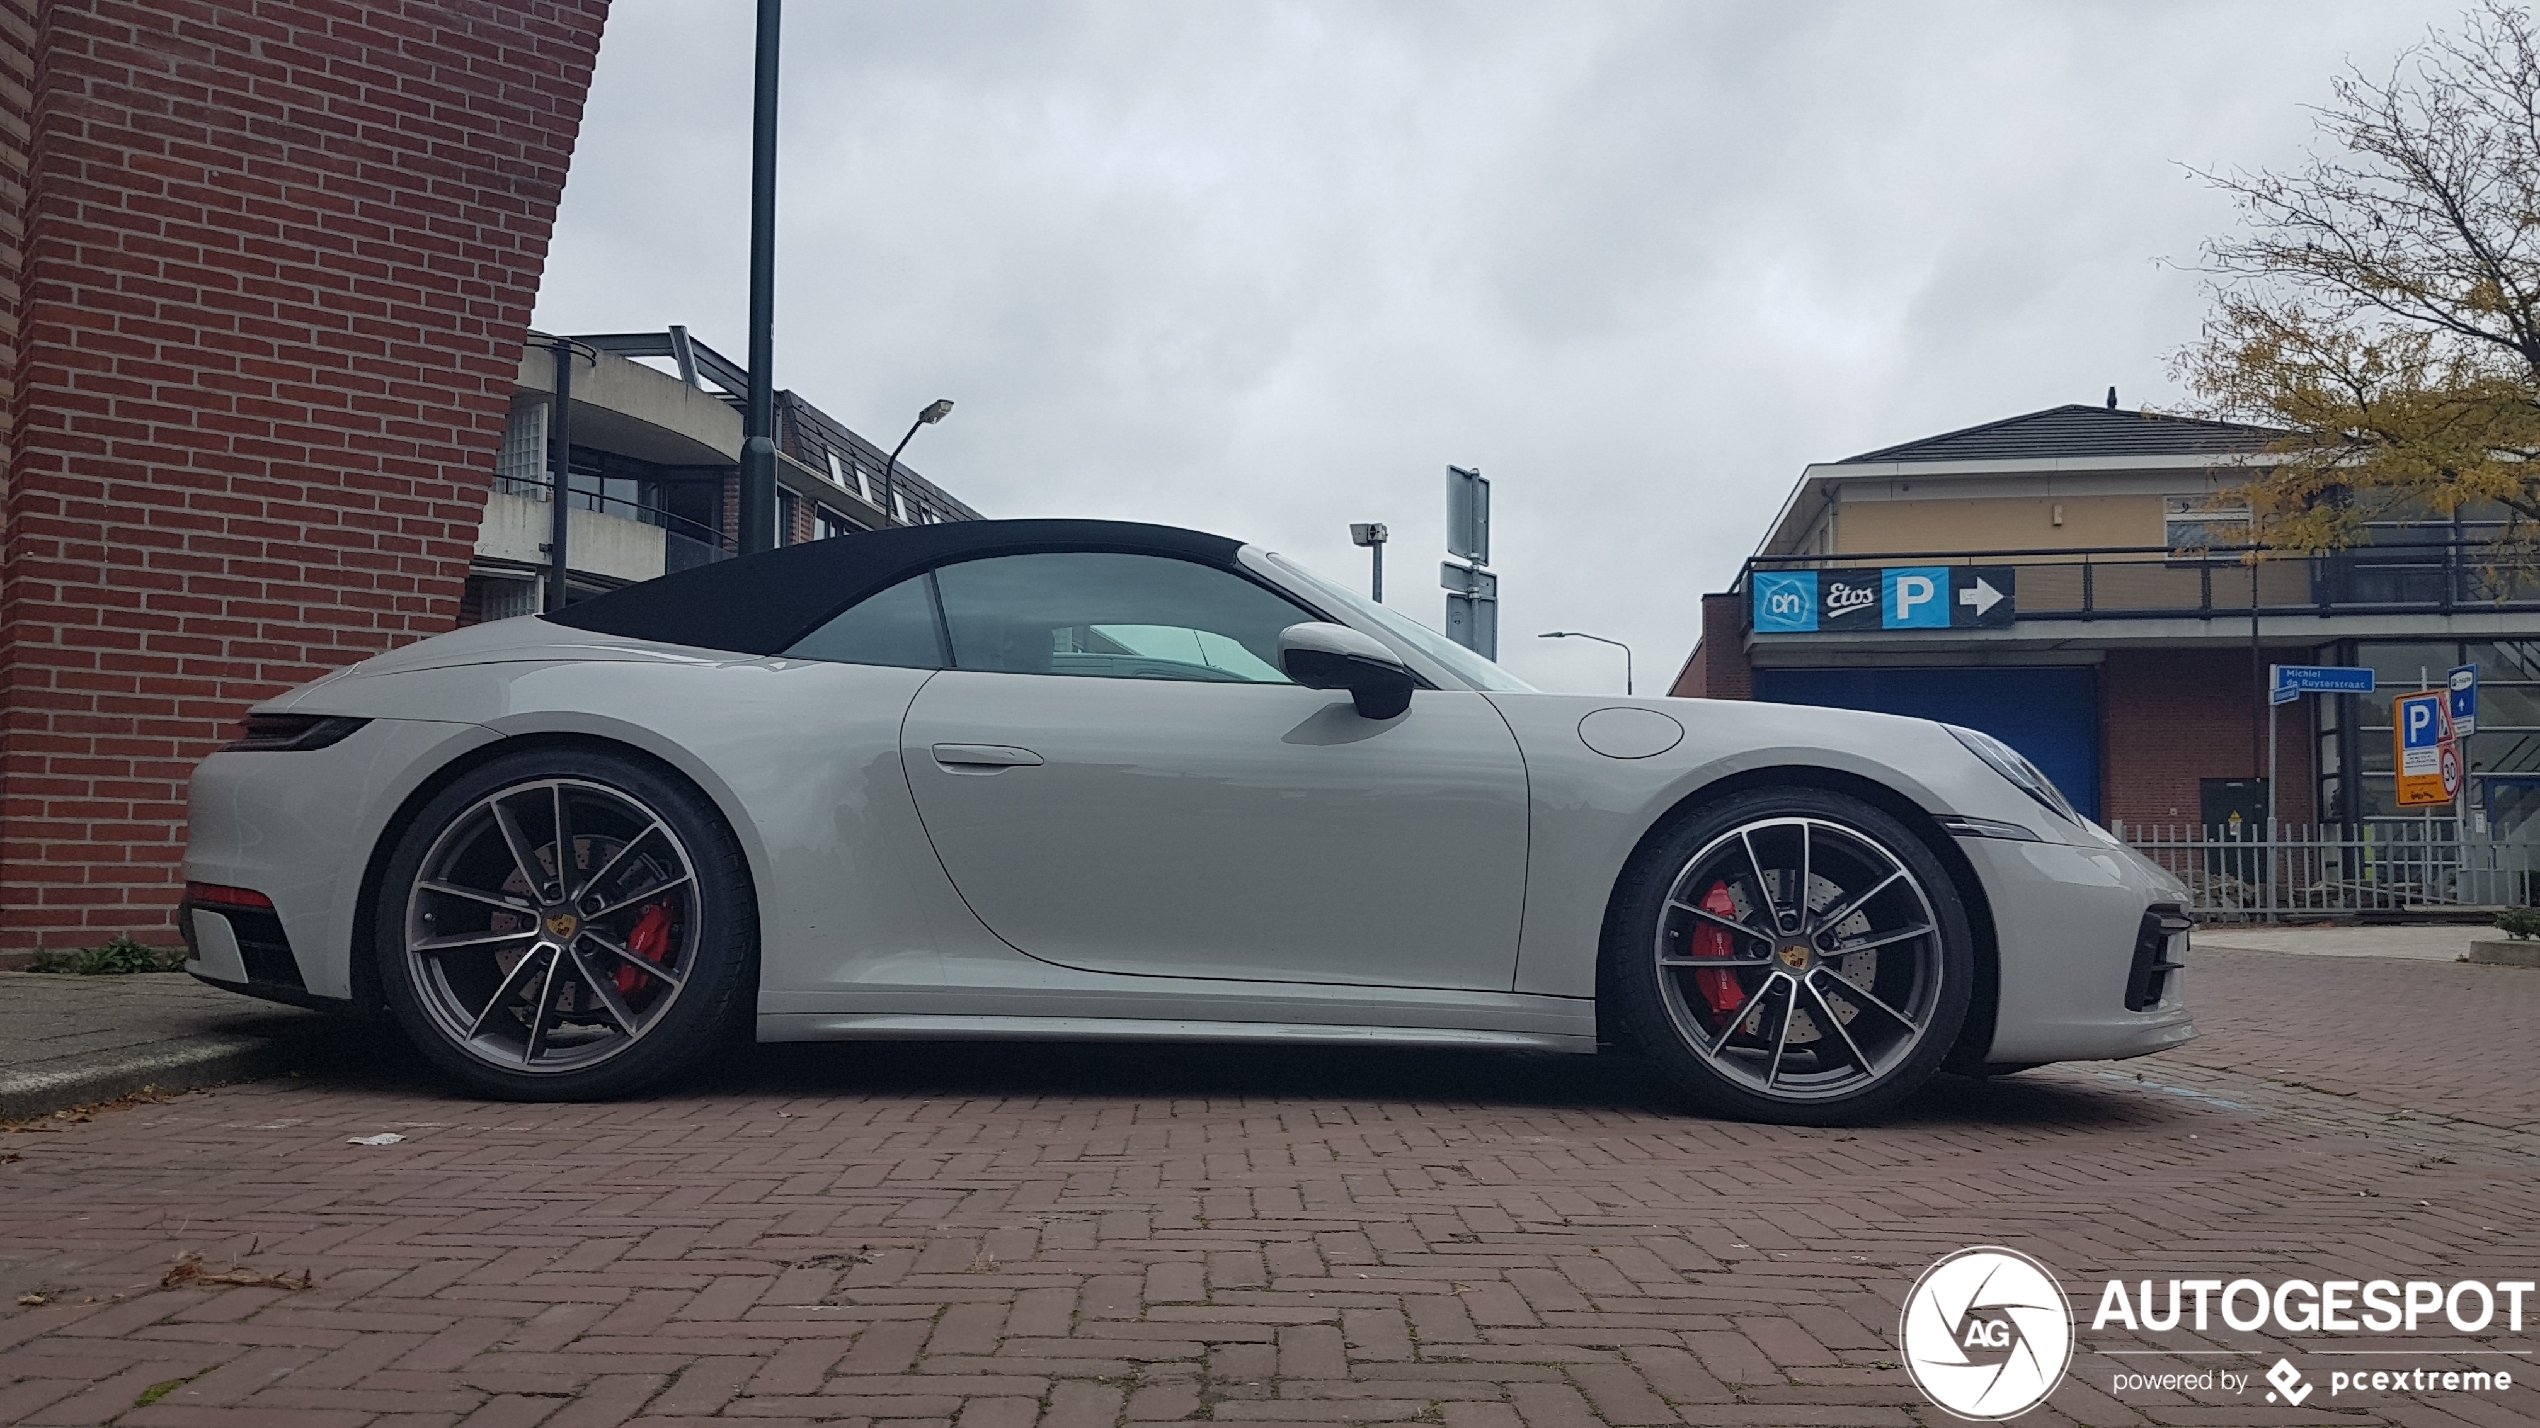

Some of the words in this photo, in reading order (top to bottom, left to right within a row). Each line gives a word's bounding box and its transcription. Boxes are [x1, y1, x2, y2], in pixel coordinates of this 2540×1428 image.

[1826, 583, 1874, 609] Etos
[1896, 576, 1935, 620] P
[2286, 669, 2321, 678] Michiel
[2286, 679, 2298, 687] de
[2301, 679, 2366, 689] Ruyterstraat
[2410, 705, 2431, 743] P
[2444, 761, 2456, 782] 30
